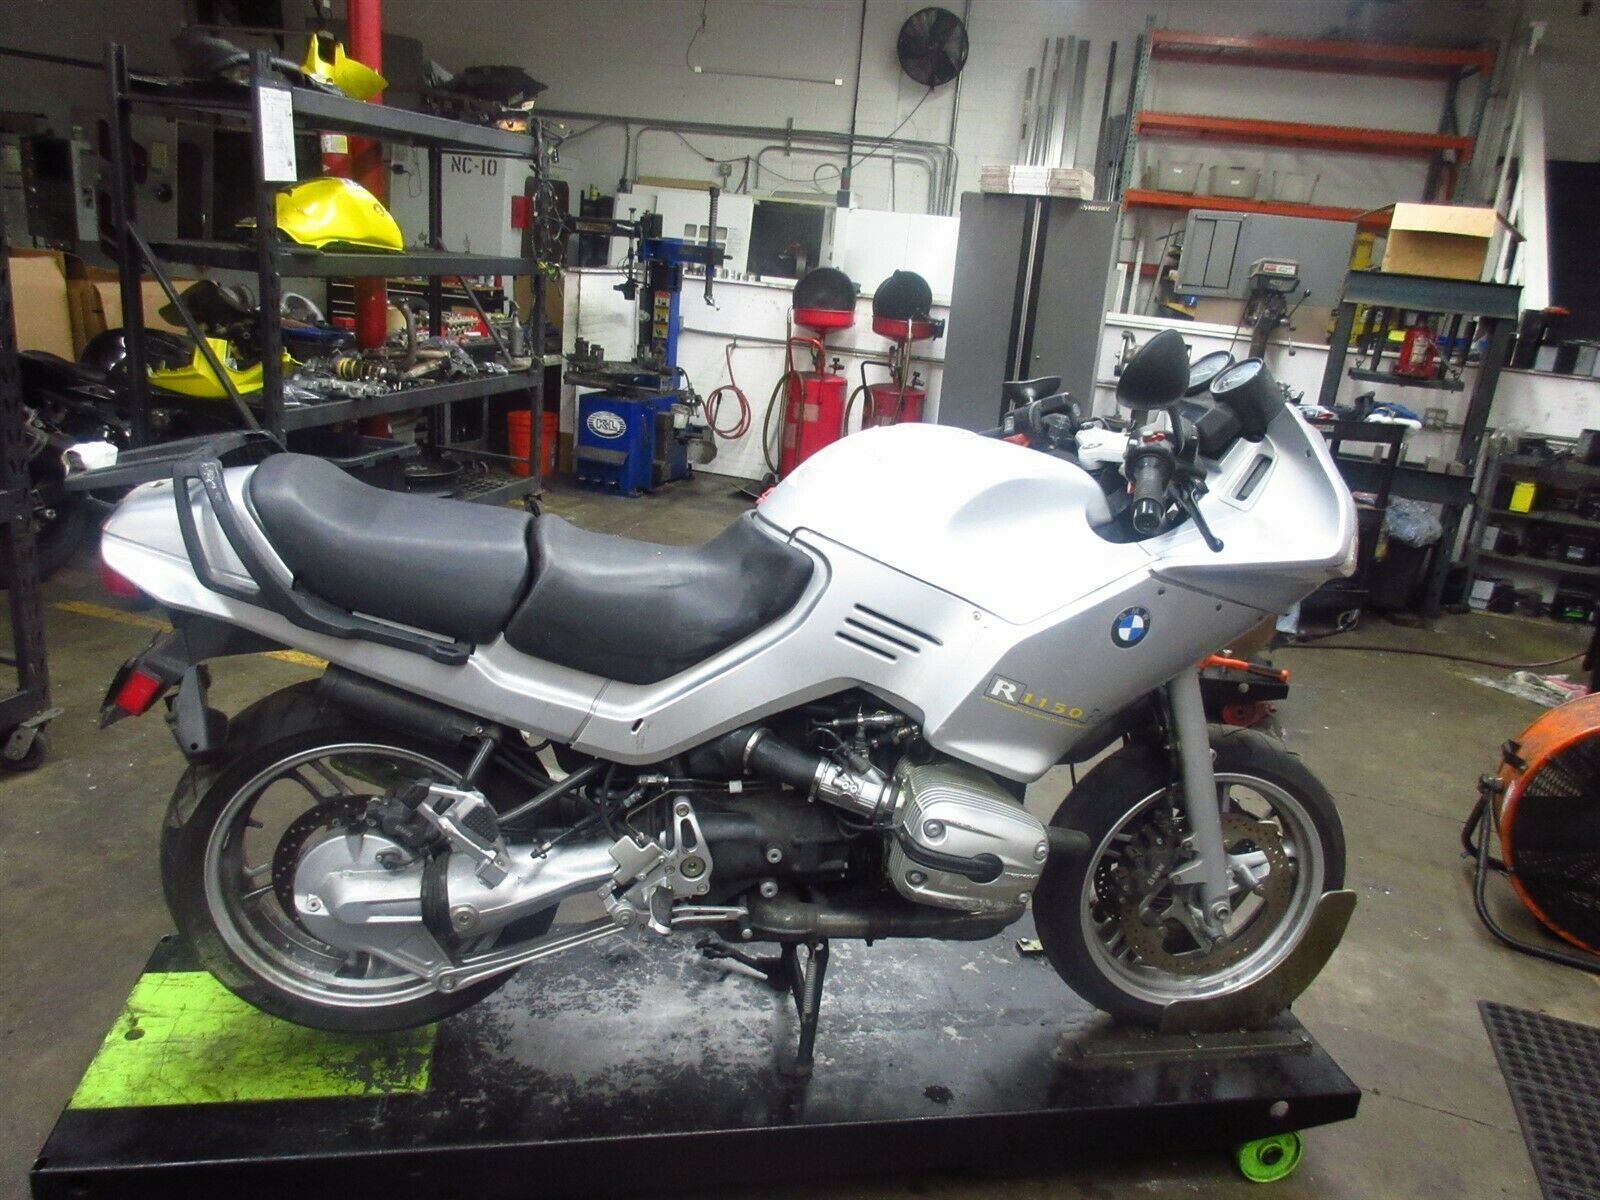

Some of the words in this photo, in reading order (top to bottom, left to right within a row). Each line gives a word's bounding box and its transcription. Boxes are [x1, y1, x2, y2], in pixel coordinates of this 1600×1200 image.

[451, 156, 498, 176] NC-10
[990, 679, 1017, 703] R
[1023, 692, 1083, 718] 1150
